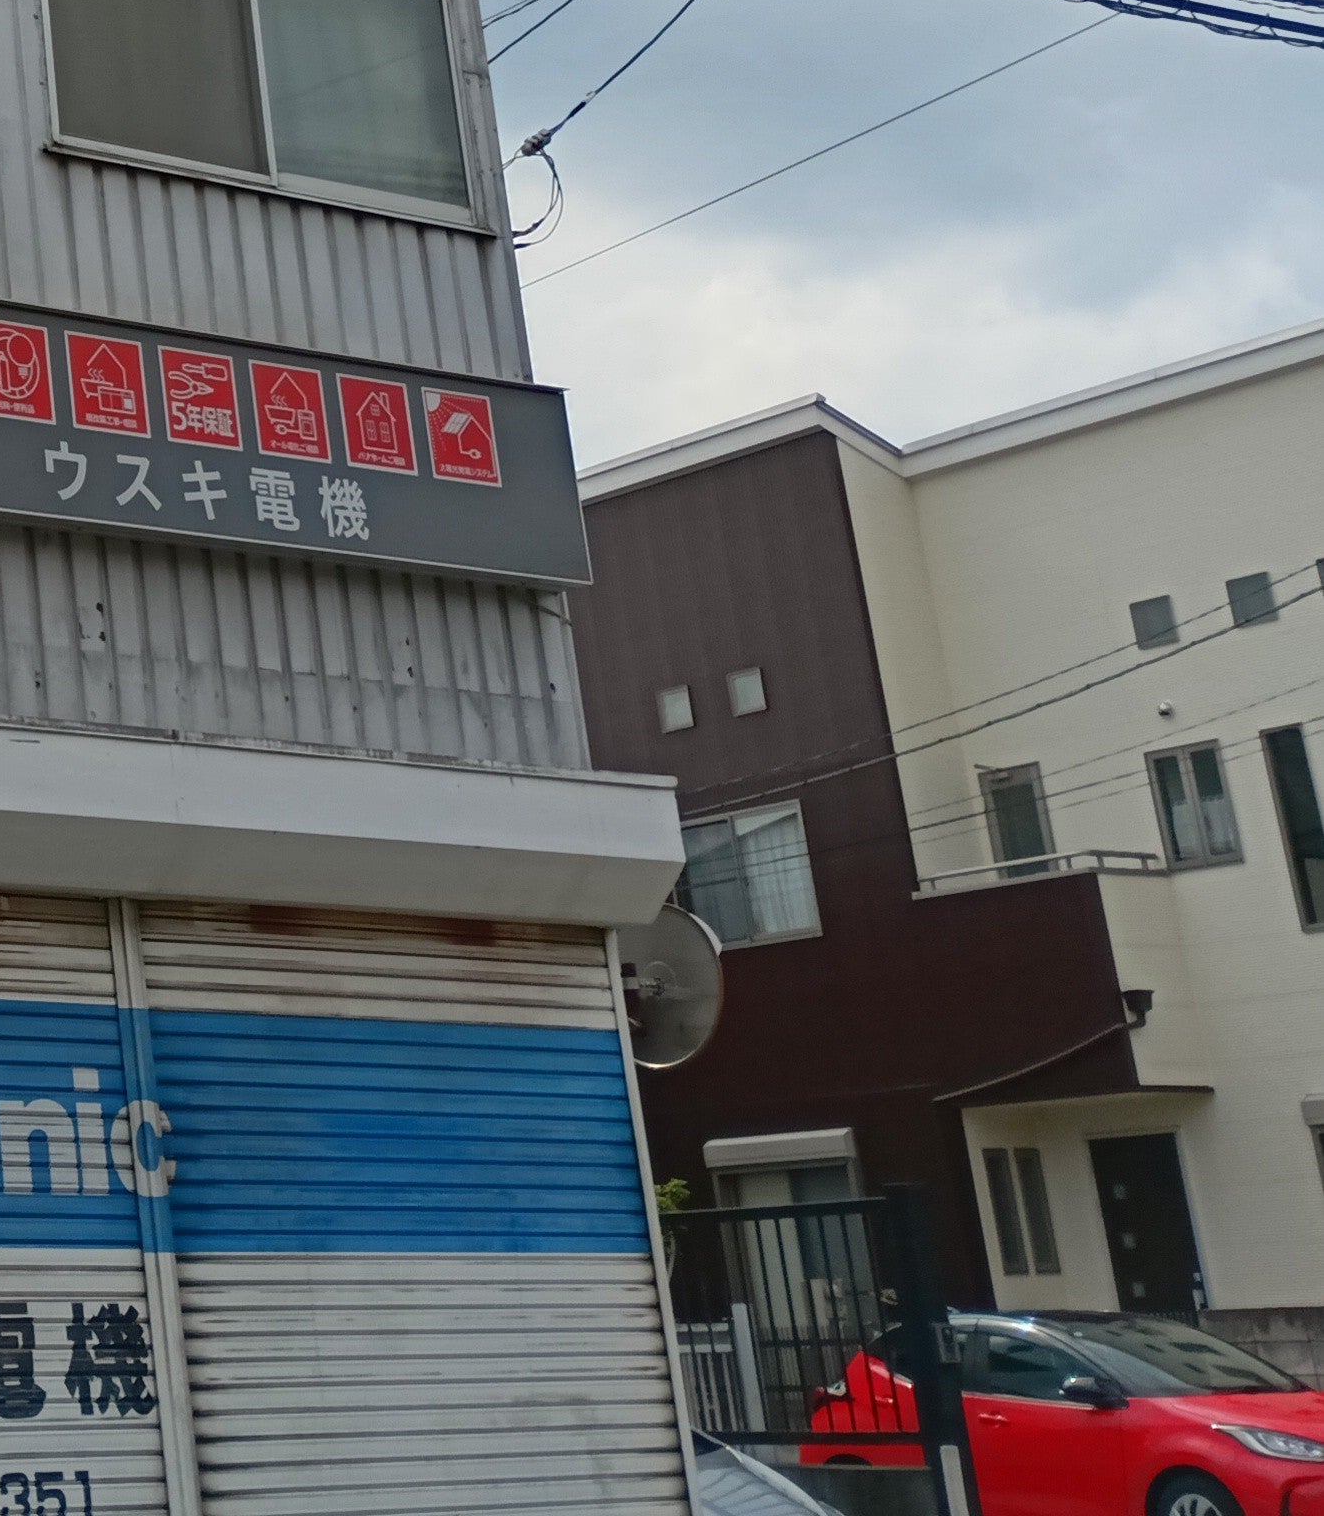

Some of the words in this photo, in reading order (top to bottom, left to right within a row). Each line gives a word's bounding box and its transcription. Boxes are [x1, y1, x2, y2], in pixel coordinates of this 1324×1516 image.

[169, 400, 236, 439] 5年保証
[44, 440, 371, 541] ウスキ電機
